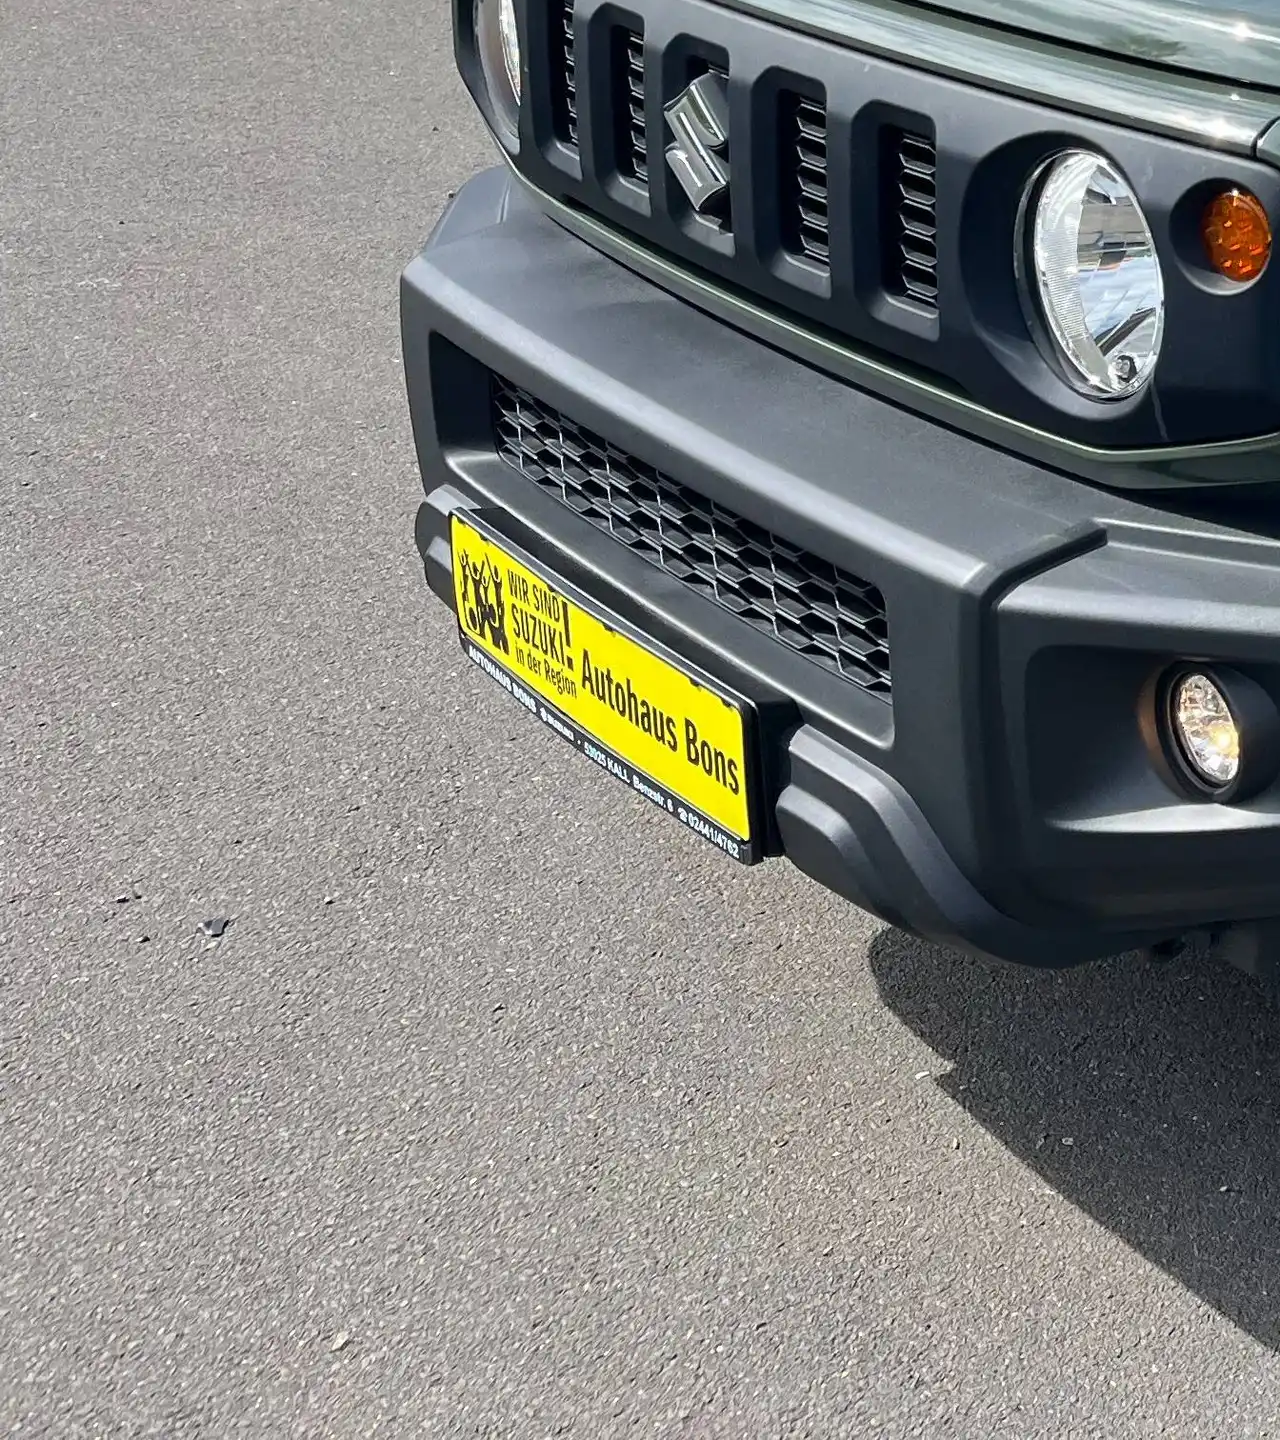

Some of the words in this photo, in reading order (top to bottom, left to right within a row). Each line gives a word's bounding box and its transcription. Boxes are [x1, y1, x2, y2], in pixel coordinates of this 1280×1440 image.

[507, 568, 531, 606] WIR
[533, 583, 560, 623] SIND
[469, 645, 512, 692] AUTOHAUS
[607, 758, 630, 783] KALL
[515, 640, 525, 666] in
[527, 648, 541, 676] der
[544, 658, 577, 699] Region
[582, 648, 678, 752] Autohaus
[685, 718, 739, 795] Bons
